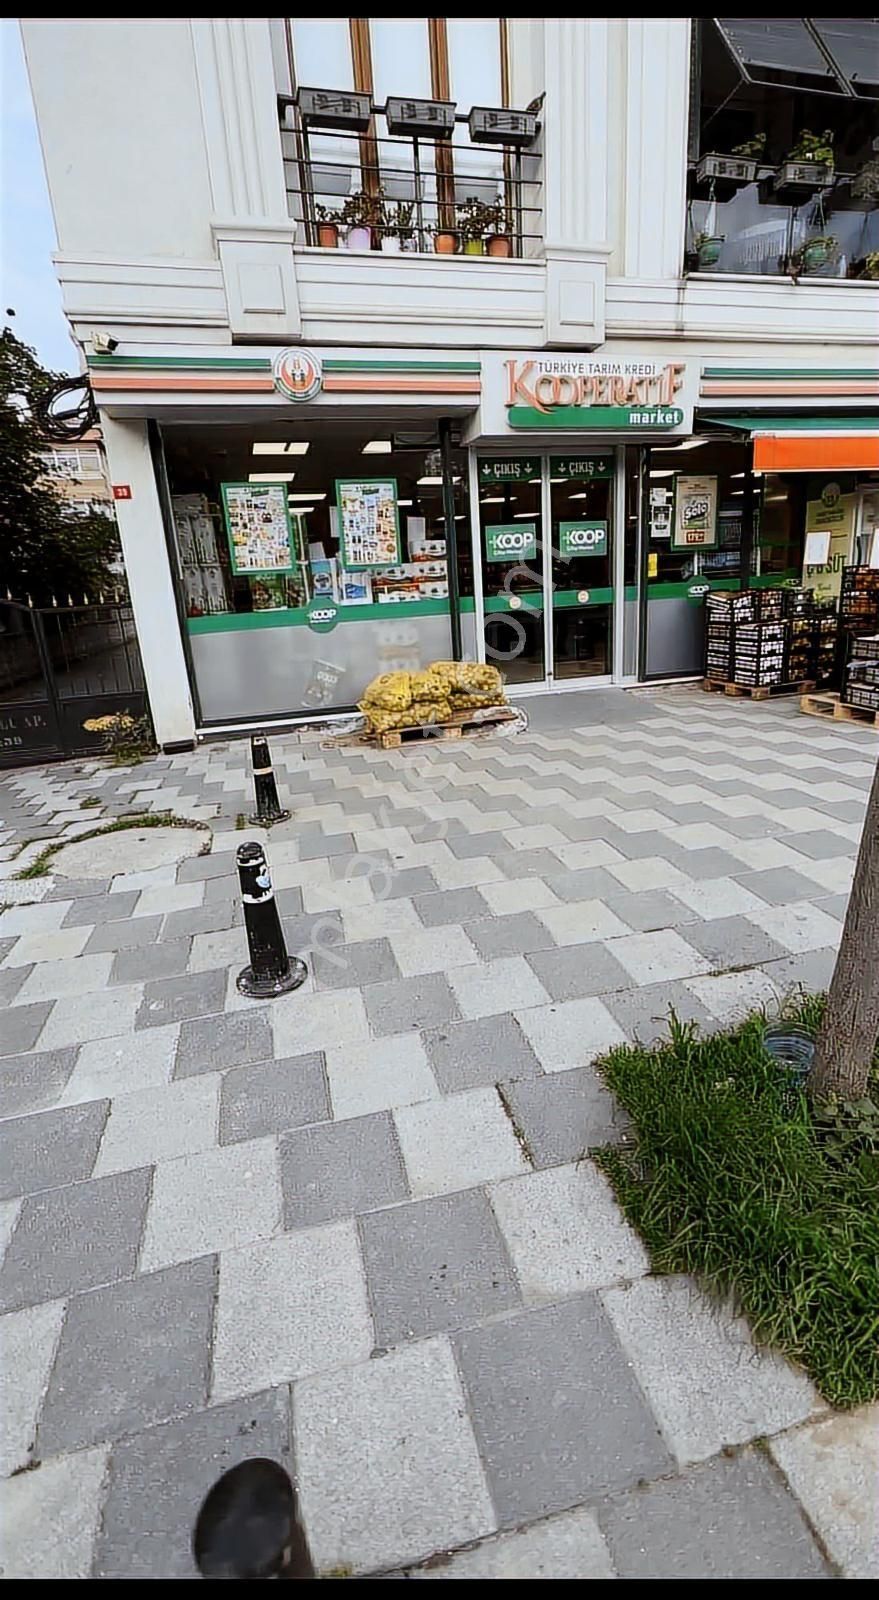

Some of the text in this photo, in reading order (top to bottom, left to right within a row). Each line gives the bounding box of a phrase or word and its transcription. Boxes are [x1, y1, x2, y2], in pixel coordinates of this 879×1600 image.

[538, 360, 584, 374] TÜRKİYE
[588, 362, 622, 375] TARIM
[629, 409, 679, 424] market
[494, 463, 521, 478] ÇIKIŞ
[569, 461, 595, 476] ÇIKIŞ
[563, 529, 606, 545] KOOP
